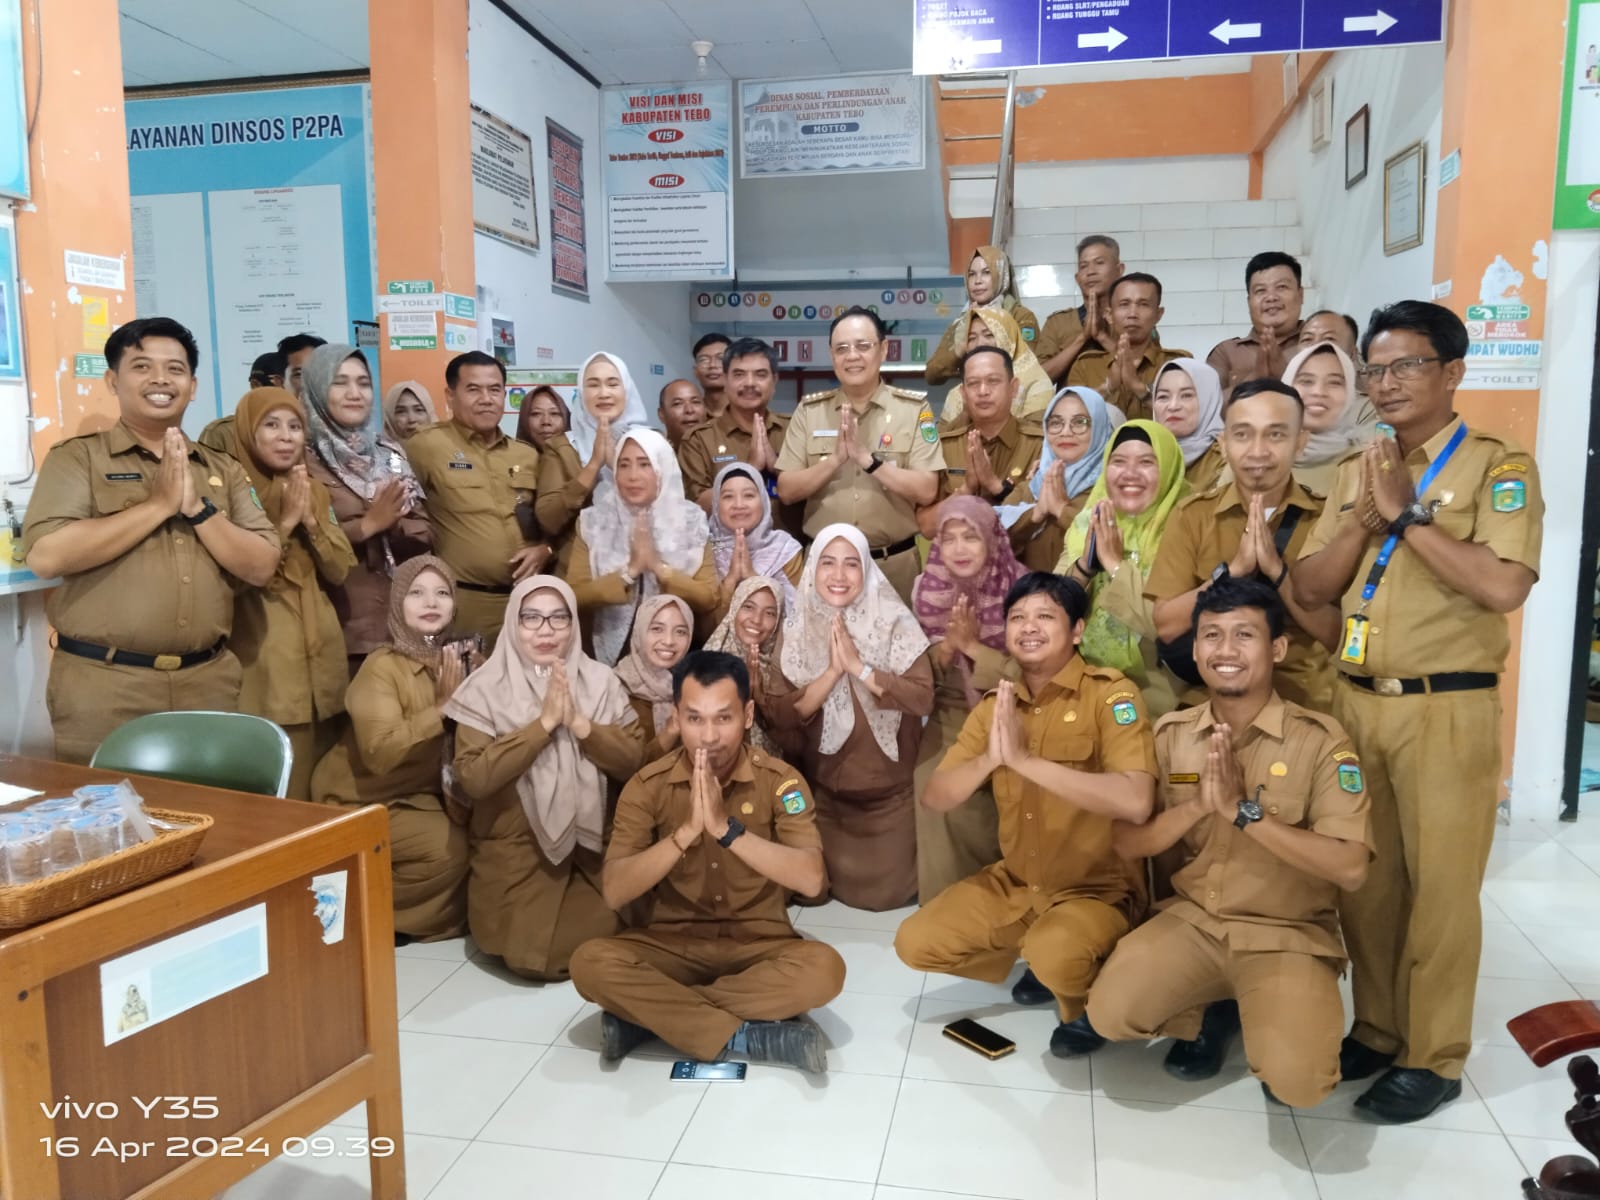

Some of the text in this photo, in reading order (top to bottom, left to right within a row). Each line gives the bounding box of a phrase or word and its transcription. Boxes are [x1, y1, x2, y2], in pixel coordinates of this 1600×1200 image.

[1102, 8, 1120, 16] TAMU
[629, 93, 703, 108] VISI DAN MISI
[770, 93, 794, 103] DINAS
[827, 87, 890, 99] PEMBERDAYAAN
[755, 96, 907, 113] PEREMPUAN DAN PERLINDUNGAN ANAK
[621, 108, 711, 124] KABUPATEN TEBO
[796, 109, 864, 121] KABUPATEN TEBO
[127, 114, 343, 150] AYANAN DINSOS P2PA
[813, 124, 847, 134] MOTTO
[655, 130, 677, 141] VISI
[654, 175, 679, 186] MISI
[401, 299, 440, 307] TOILET
[1498, 343, 1539, 355] WUDHU
[1480, 375, 1536, 384] TOILET
